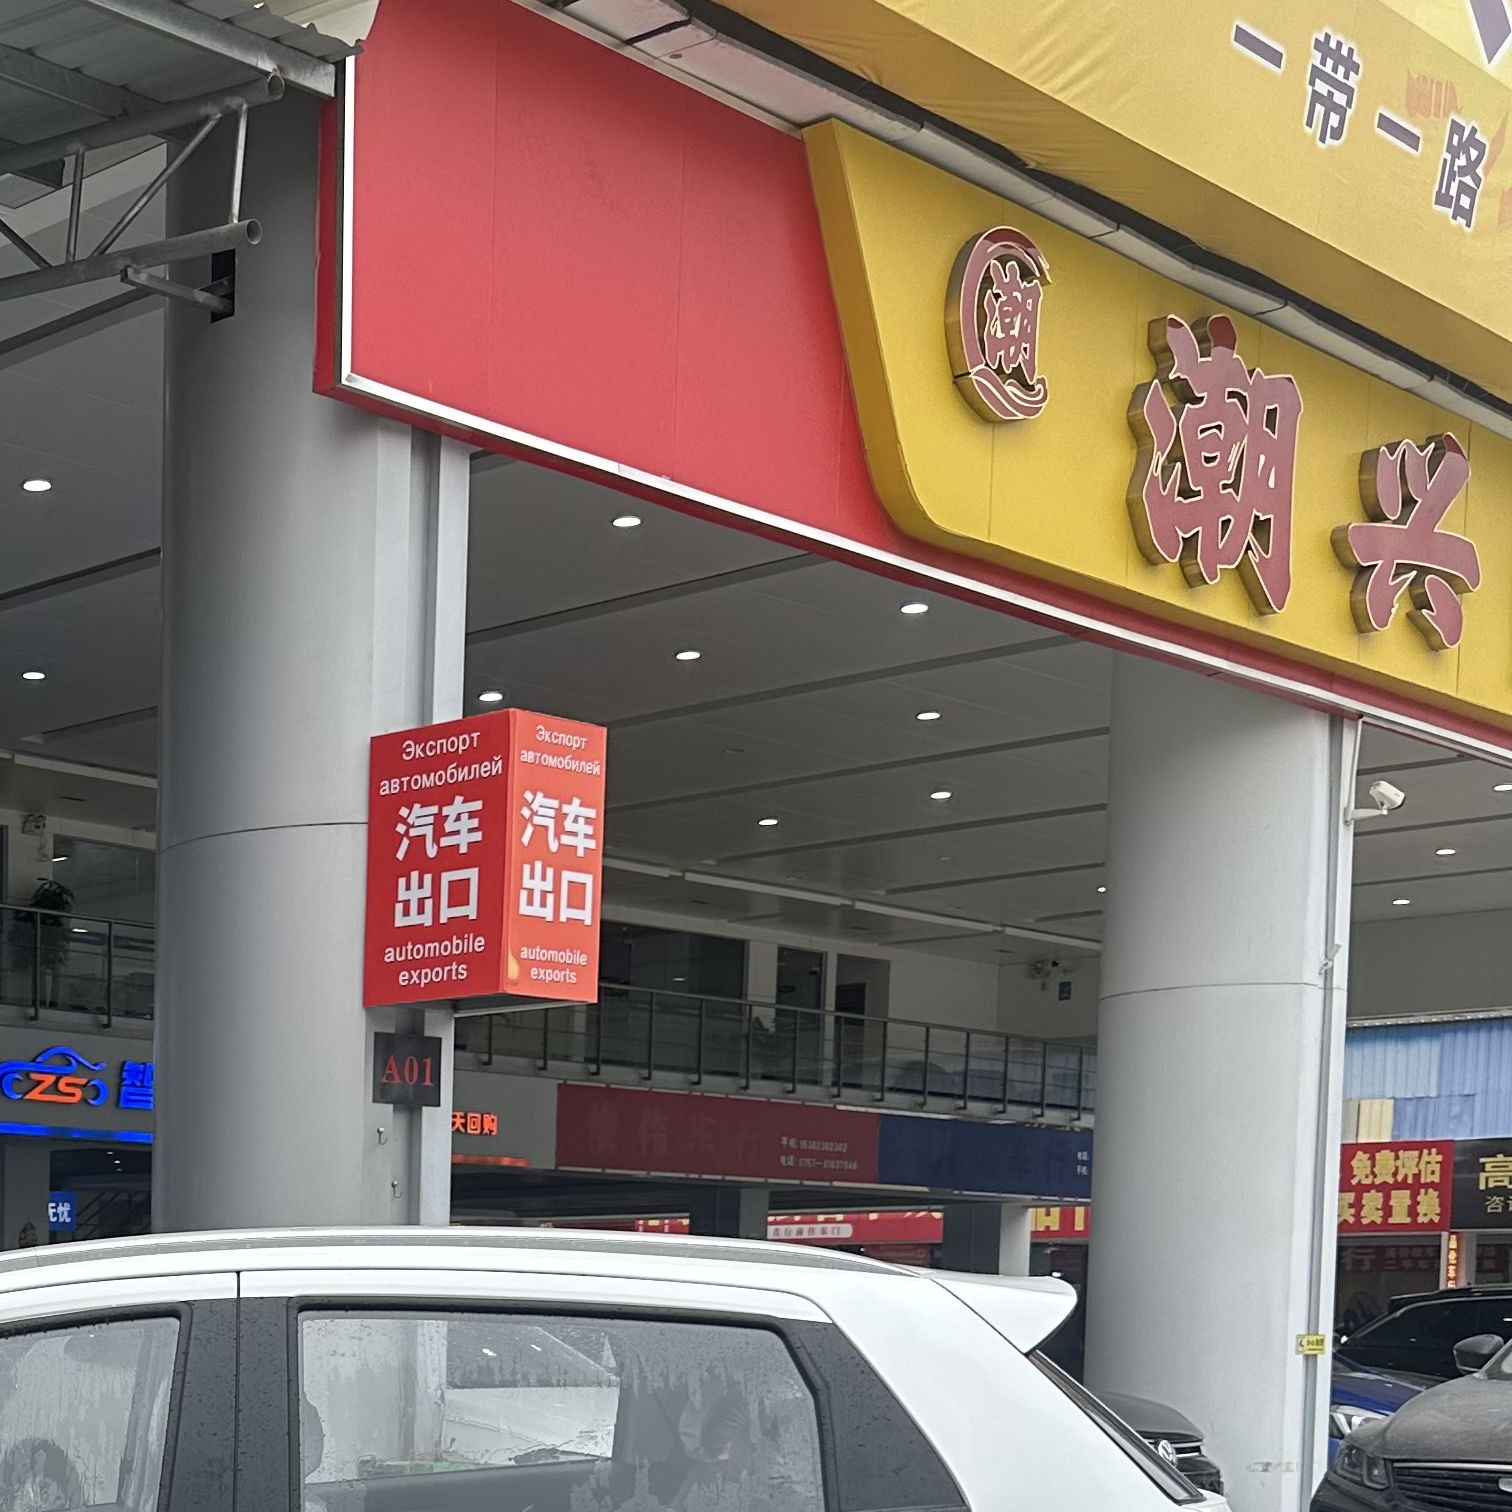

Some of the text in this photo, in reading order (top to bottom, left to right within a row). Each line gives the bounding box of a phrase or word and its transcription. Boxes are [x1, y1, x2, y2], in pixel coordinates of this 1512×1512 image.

[1233, 24, 1487, 229] 一带一路
[1128, 313, 1482, 652] 潮兴
[402, 731, 481, 762] Экспорт
[535, 725, 587, 751] Экспорт
[379, 755, 503, 796] автомобилей
[520, 750, 601, 776] автомобилей
[395, 795, 483, 862] 汽车
[520, 789, 597, 858] 汽车
[394, 866, 480, 928] 出口
[518, 860, 594, 926] 出口
[384, 933, 485, 964] automobile
[520, 945, 588, 967] automobile
[399, 961, 468, 987] exports
[530, 963, 577, 985] exports
[381, 1055, 435, 1087] A01
[451, 1112, 498, 1136] 天回购
[1350, 1148, 1443, 1186] 免费评估
[1478, 1153, 1512, 1191] 高
[1338, 1188, 1441, 1225] 买卖置换
